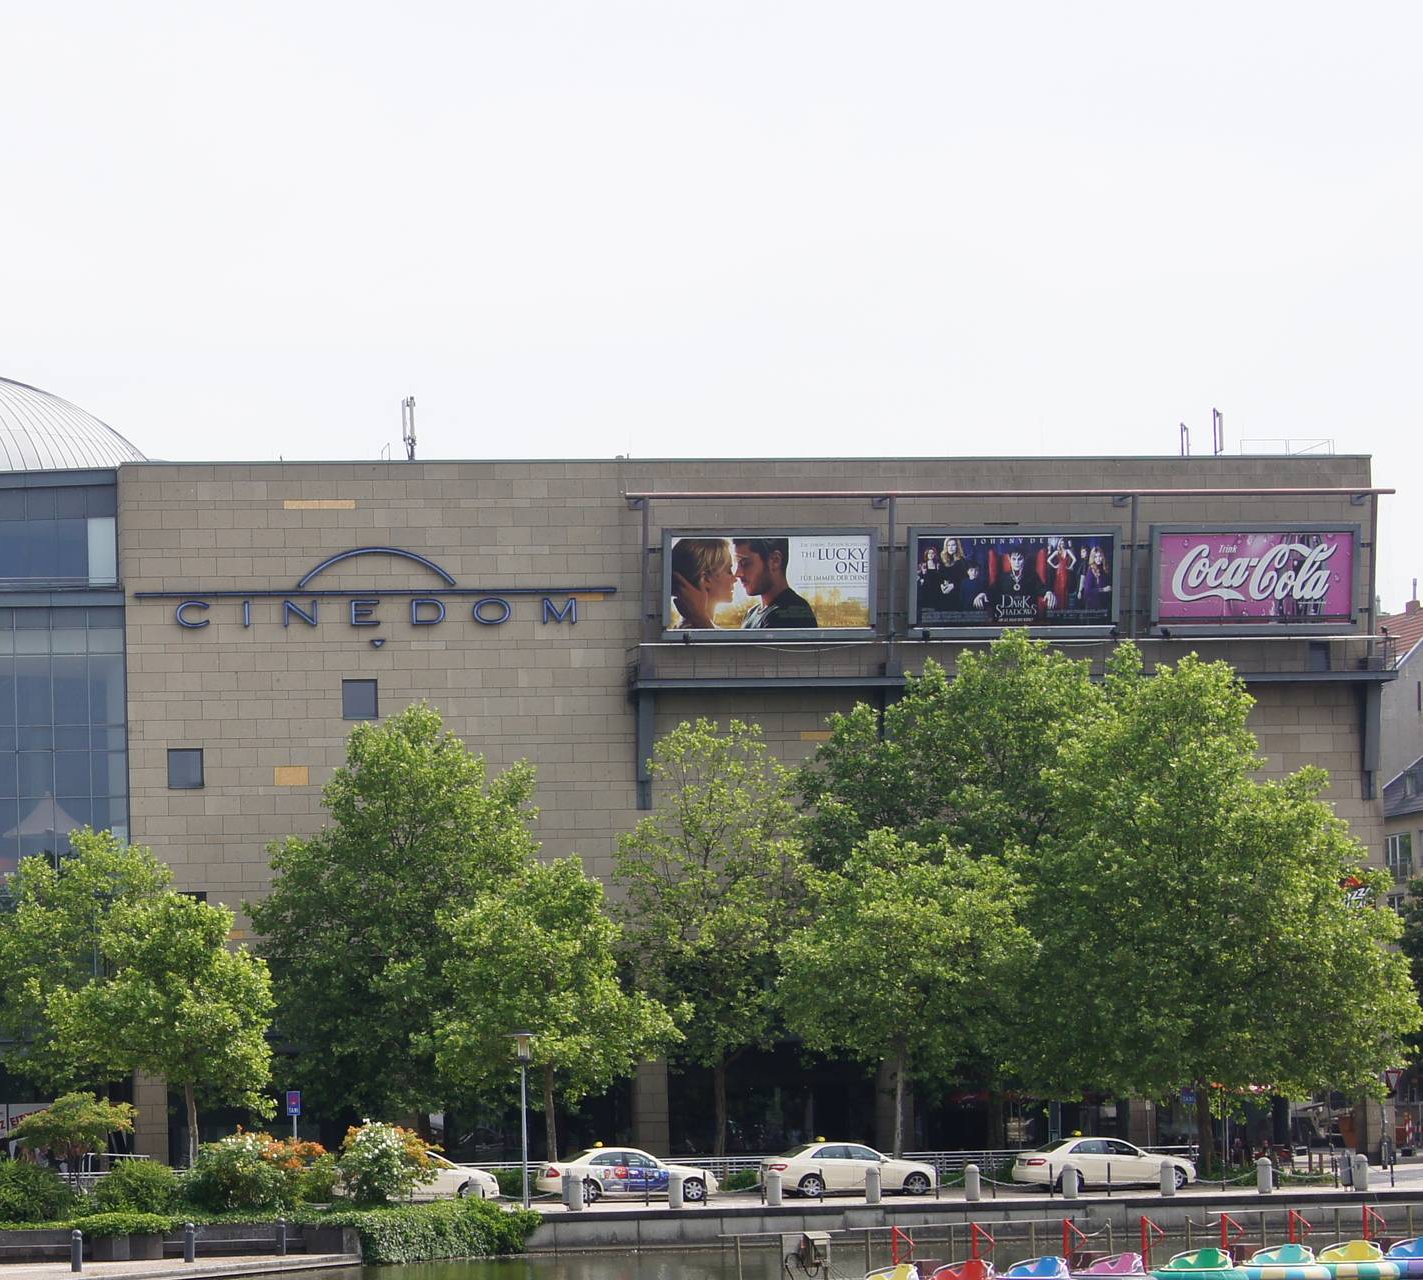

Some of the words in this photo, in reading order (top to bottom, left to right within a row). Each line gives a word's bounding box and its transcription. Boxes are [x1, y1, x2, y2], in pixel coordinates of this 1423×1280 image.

[973, 538, 1023, 546] JOHNNY
[801, 551, 815, 559] THE
[818, 548, 867, 561] LUCKY
[1218, 544, 1238, 554] Trink
[835, 561, 870, 574] ONE
[1172, 543, 1338, 601] Coca-Cola
[1001, 594, 1031, 608] DARK
[175, 597, 578, 629] CINEDOM
[994, 603, 1038, 618] SHADOWS
